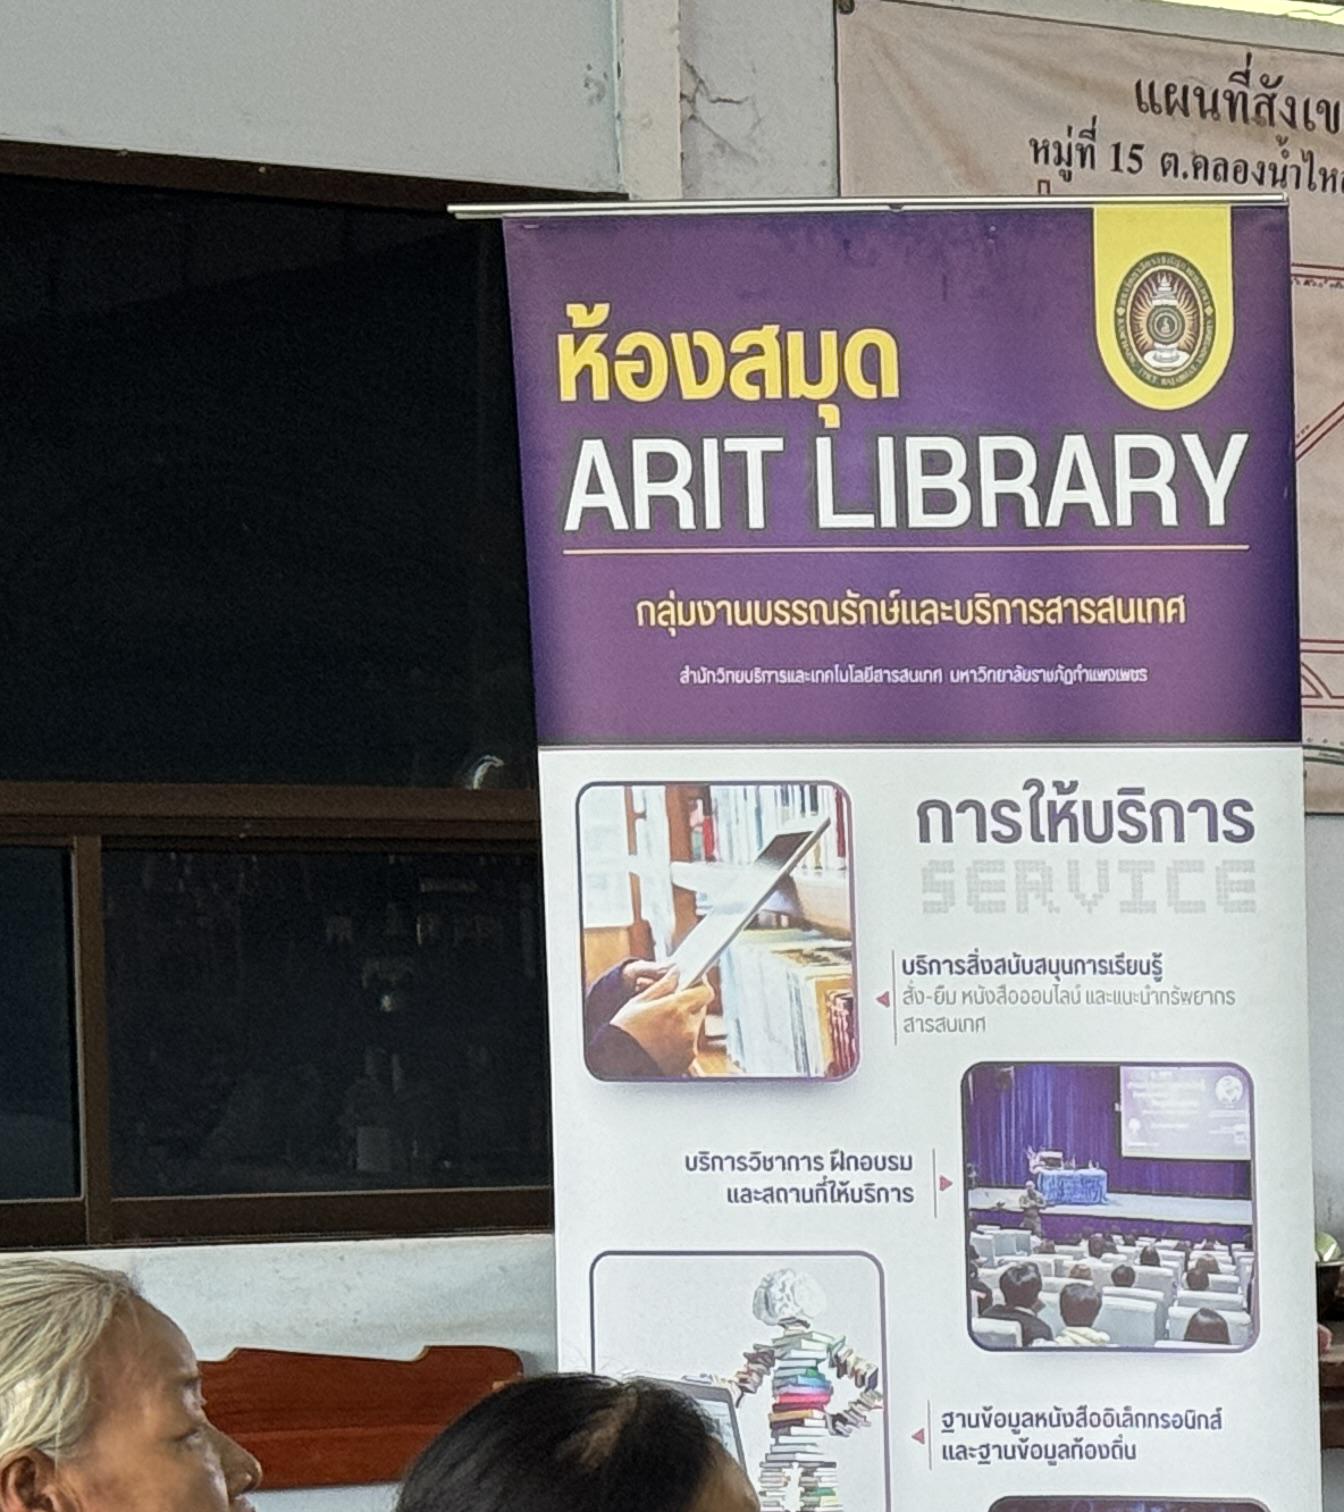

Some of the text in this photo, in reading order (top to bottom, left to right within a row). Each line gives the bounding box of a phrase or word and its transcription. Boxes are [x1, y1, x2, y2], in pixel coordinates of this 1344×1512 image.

[1029, 116, 1097, 182] หมู่ที่
[1110, 141, 1144, 174] 15
[557, 303, 900, 428] ห้องสมุด
[563, 433, 1249, 532] ARIT LIBRARY
[636, 590, 1187, 637] กลุ่มงานบรรณรักษ์และบริการสารสนเทศ
[917, 779, 1256, 844] การให้บริการ
[921, 858, 1257, 915] SERVICE
[902, 949, 1163, 982] บริการสิ่งสนับสนุนการเรียนรู้
[902, 1015, 986, 1034] สารสนเทศ
[684, 1149, 913, 1172] บริการวิชาการ ฝึกอบรม
[726, 1176, 915, 1204] และสถานที่ให้บริการ
[941, 1405, 1223, 1435] ฐานข้อมูลหนังสืออิเล็กทรอนิกส์
[942, 1434, 1137, 1466] และฐานข้อมูลท้องถิ่น
